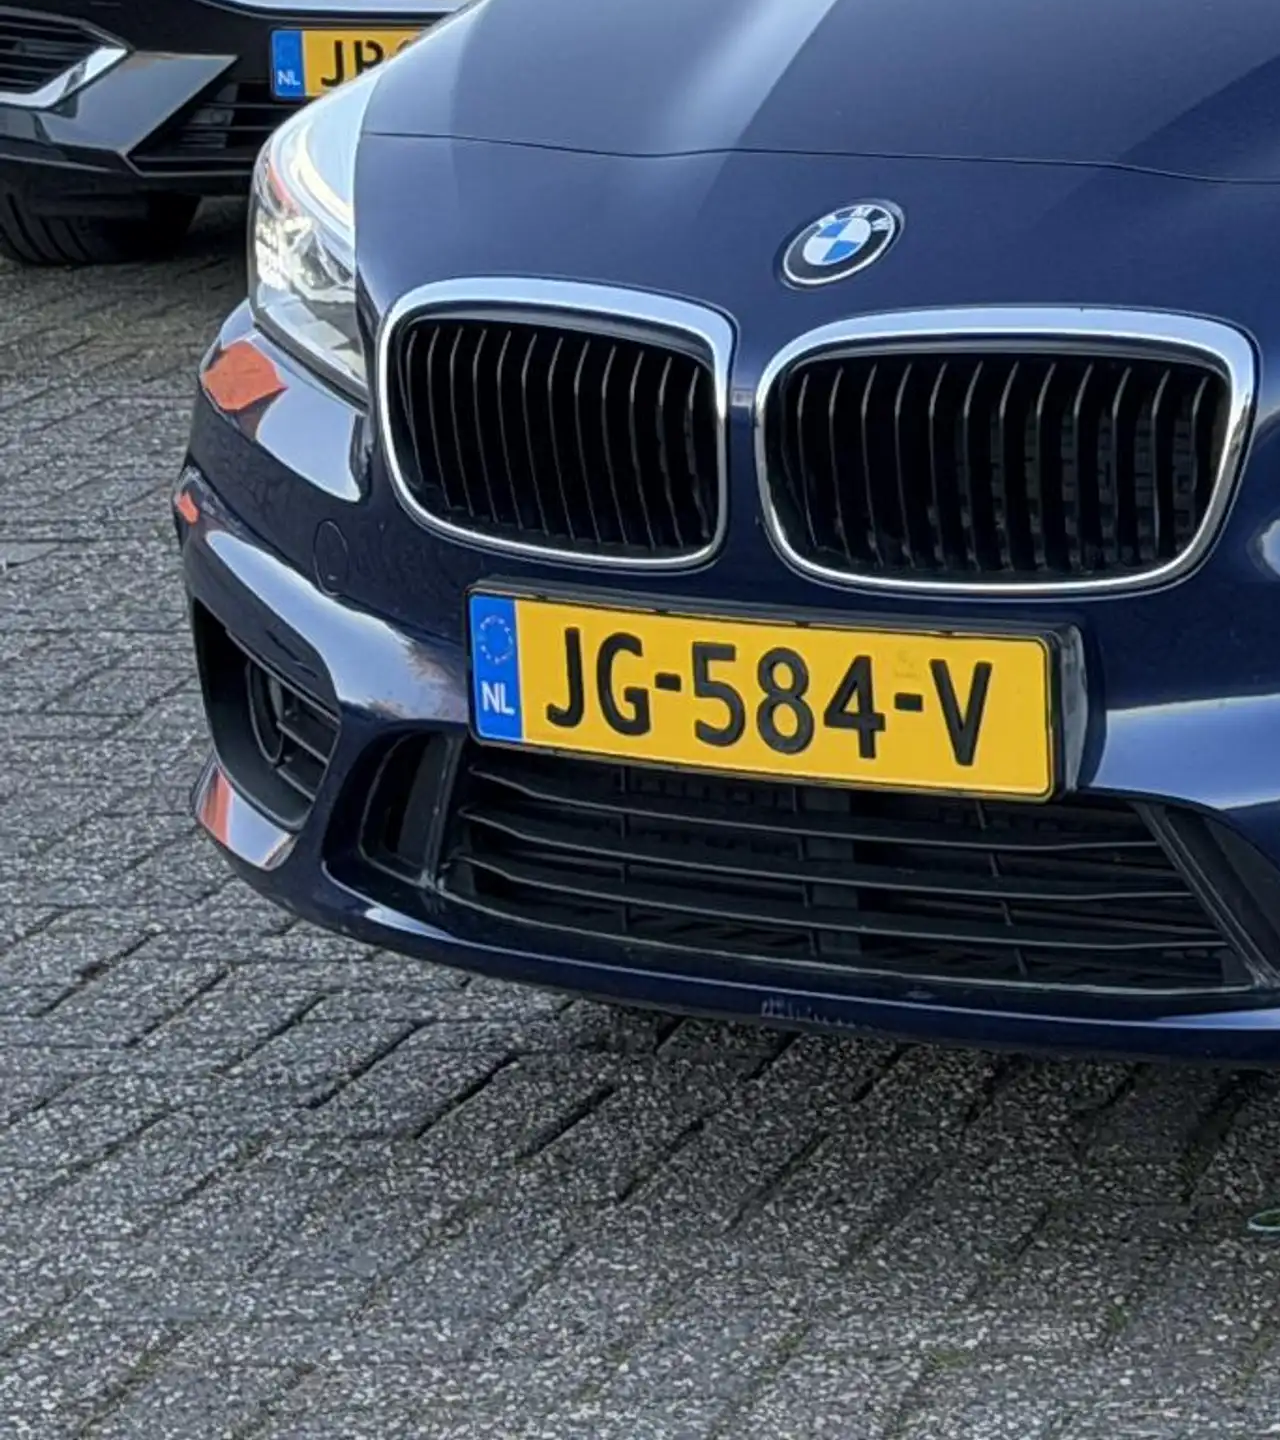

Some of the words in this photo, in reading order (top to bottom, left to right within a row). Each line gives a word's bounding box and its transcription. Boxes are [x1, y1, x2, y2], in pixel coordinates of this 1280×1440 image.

[277, 70, 301, 87] NL
[321, 39, 412, 87] JP
[481, 683, 515, 717] NL
[546, 626, 992, 767] JG-584-V
